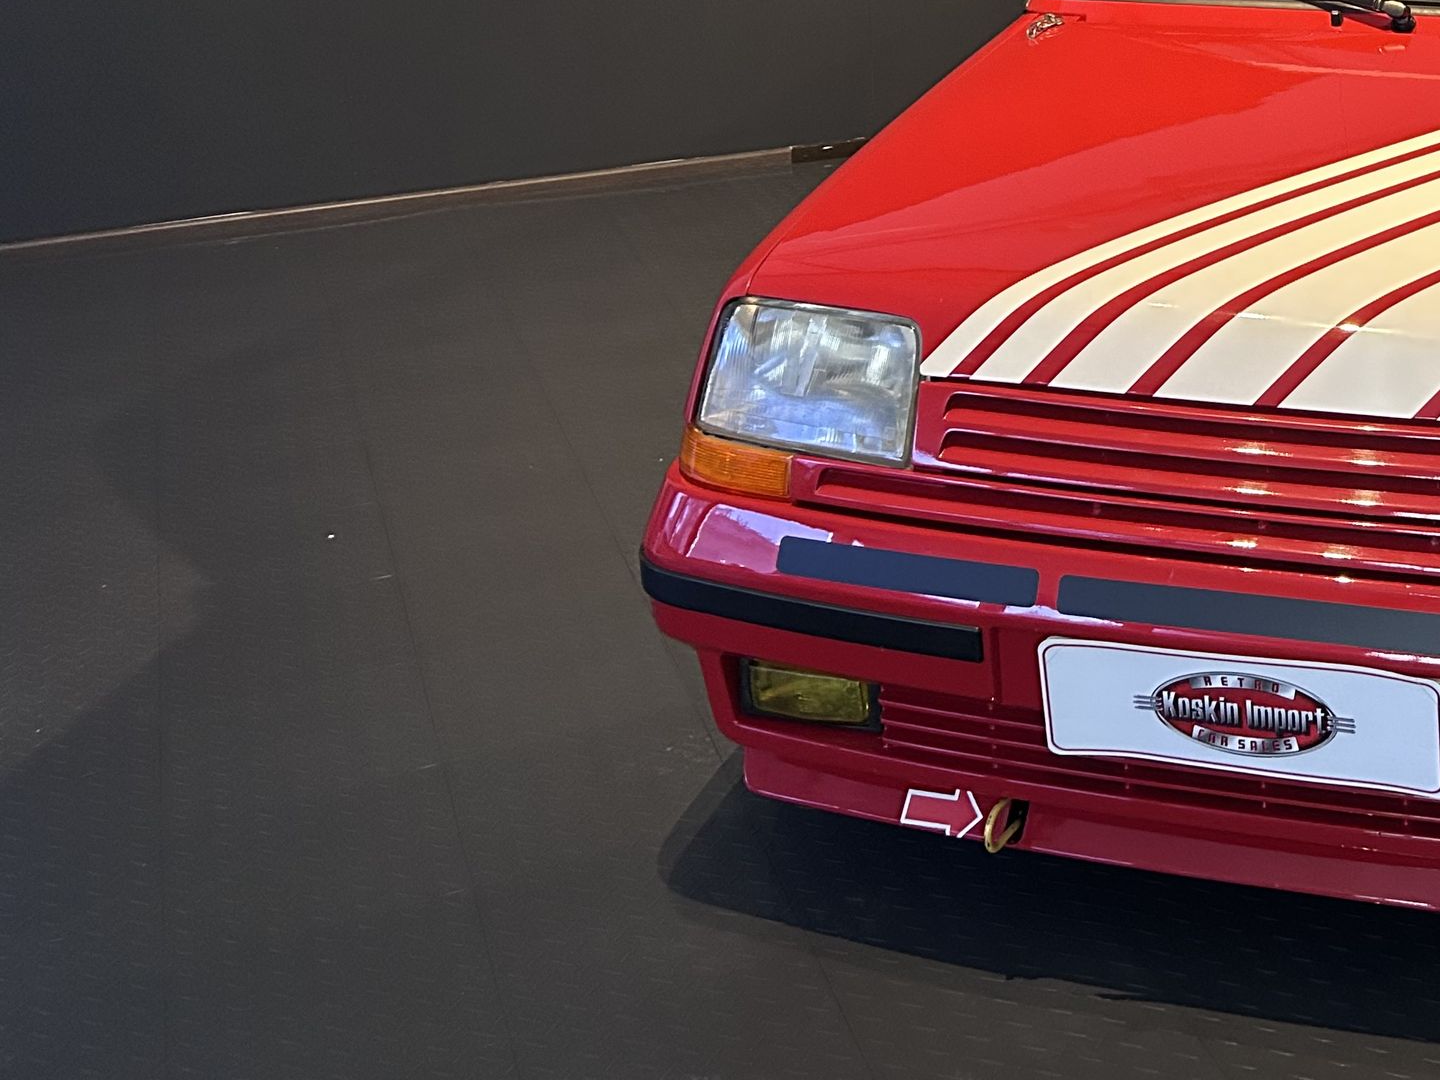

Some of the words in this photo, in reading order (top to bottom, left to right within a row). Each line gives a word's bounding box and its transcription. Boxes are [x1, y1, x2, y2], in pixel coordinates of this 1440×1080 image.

[1203, 676, 1279, 693] RETRO
[1162, 690, 1240, 724] Koskin
[1245, 699, 1325, 734] Import
[1197, 728, 1228, 747] CAR
[1237, 738, 1293, 751] SALES
